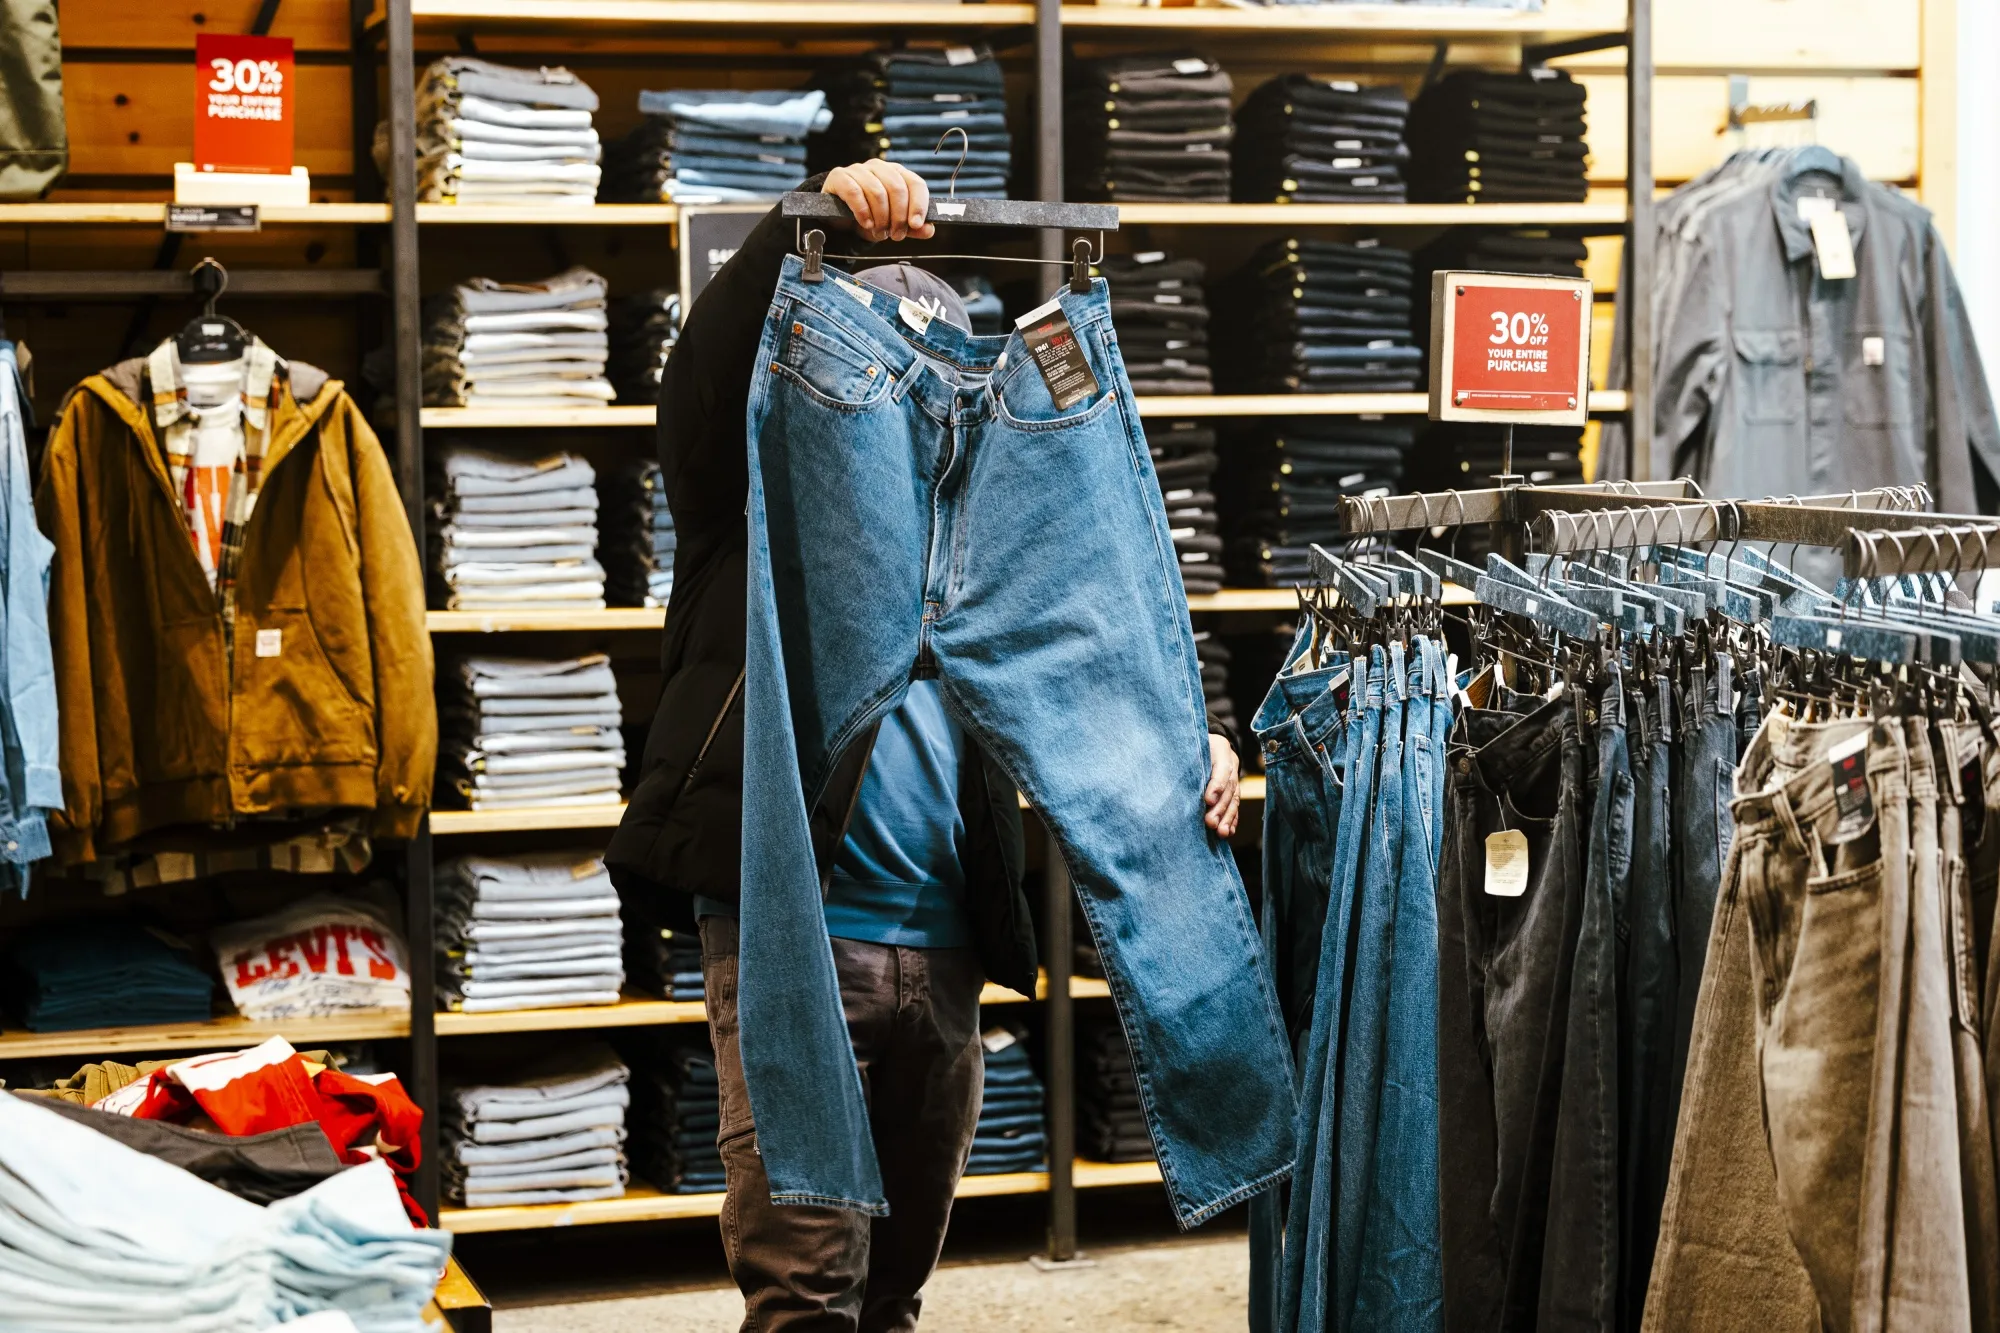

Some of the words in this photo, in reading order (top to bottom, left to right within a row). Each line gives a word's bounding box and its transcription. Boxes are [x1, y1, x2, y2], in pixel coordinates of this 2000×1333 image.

[209, 58, 283, 93] 30%
[258, 82, 282, 94] OFF
[208, 94, 240, 106] YOUR
[241, 95, 282, 108] ENTIRE
[208, 105, 282, 121] PURCHASE
[1489, 311, 1549, 345] 30%
[1529, 336, 1549, 346] OFF
[1034, 342, 1049, 354] 1961
[1487, 348, 1513, 359] YOUR
[1515, 350, 1548, 360] ENTIRE
[1487, 360, 1548, 373] PURCHASE
[235, 923, 396, 989] LEVI'S
